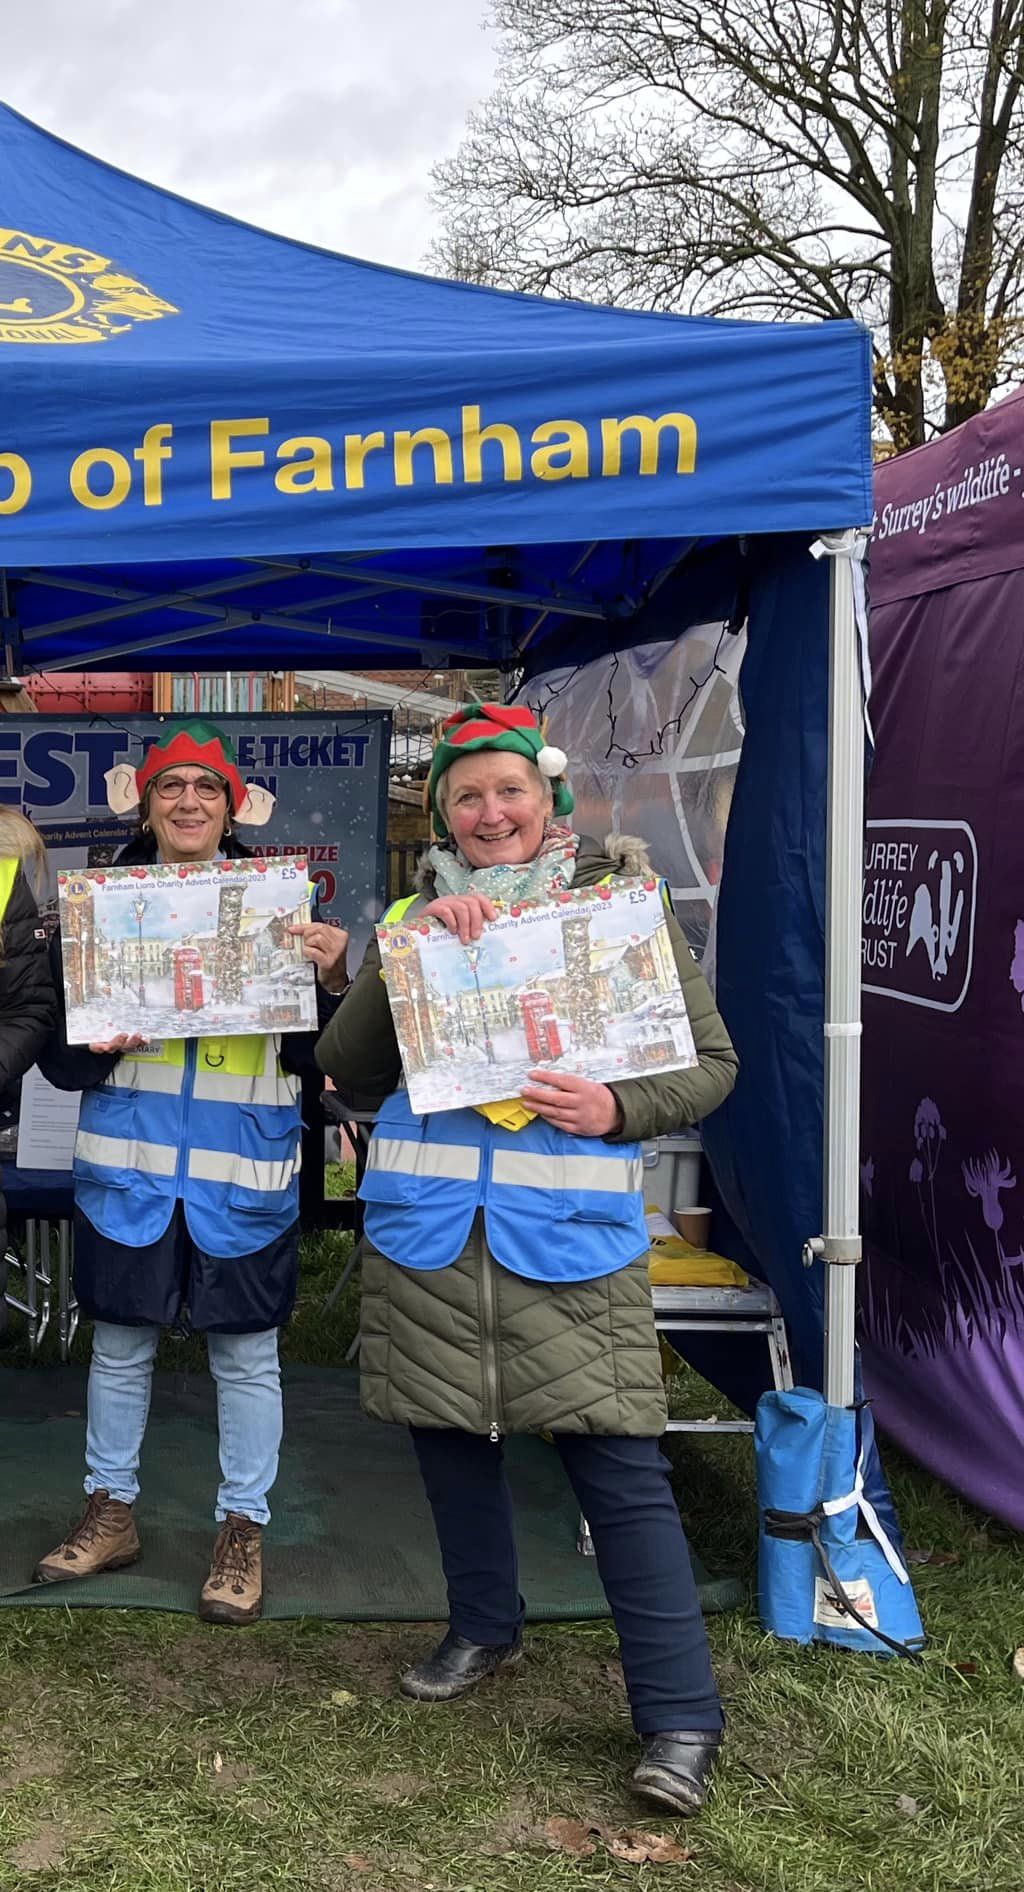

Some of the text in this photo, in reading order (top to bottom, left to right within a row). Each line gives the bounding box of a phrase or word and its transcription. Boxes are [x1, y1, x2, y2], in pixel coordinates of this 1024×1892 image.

[69, 423, 173, 510] of
[210, 404, 697, 499] Farnham
[878, 483, 945, 540] Surrey's
[945, 454, 1010, 515] wildlife
[260, 734, 369, 768] TICKET
[64, 830, 92, 840] Advent
[863, 842, 919, 871] URREY
[102, 883, 135, 892] Farnham
[157, 879, 184, 889] Charity
[185, 877, 212, 886] Advent
[281, 867, 297, 880] £5
[629, 889, 647, 904] £5
[487, 917, 519, 932] Charity
[520, 912, 550, 925] Advent
[591, 901, 613, 912] 2023
[862, 937, 898, 969] RUST
